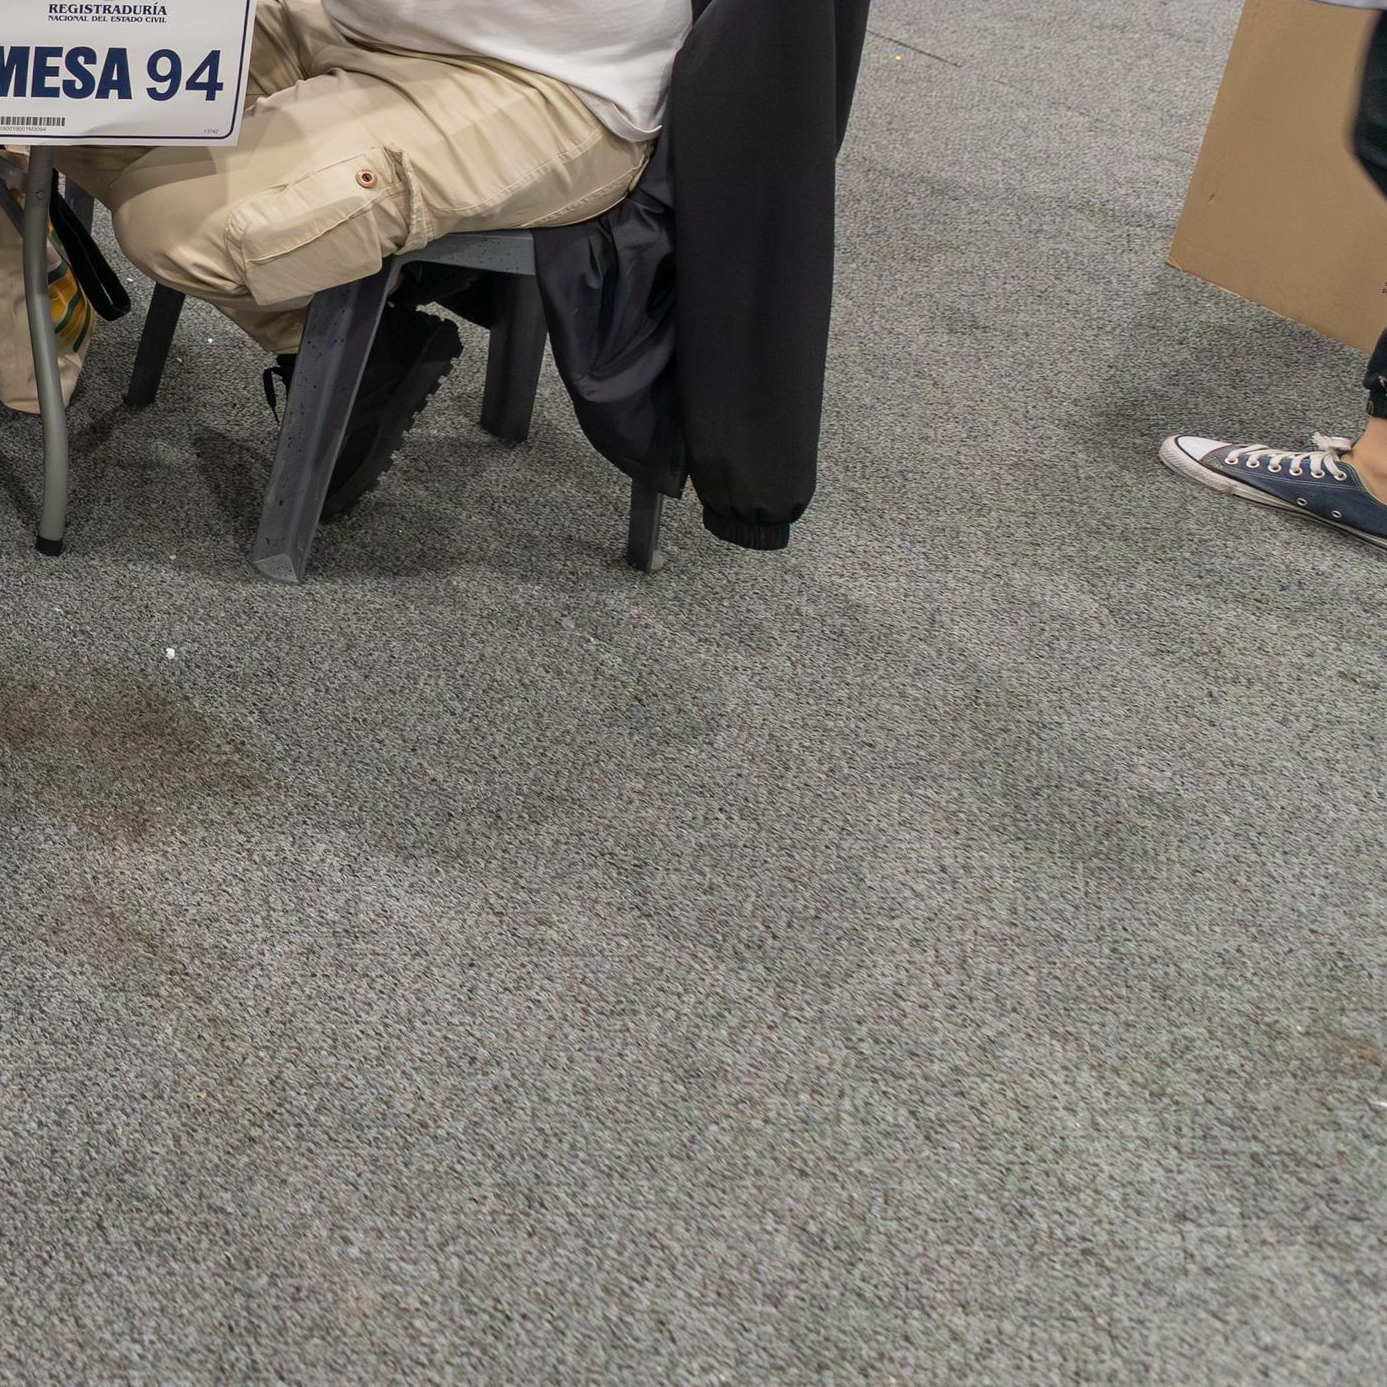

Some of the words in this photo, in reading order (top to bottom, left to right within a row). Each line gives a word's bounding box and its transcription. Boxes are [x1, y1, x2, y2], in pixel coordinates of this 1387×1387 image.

[48, 2, 167, 16] REGISTRADURÍA
[91, 15, 108, 23] DEL
[110, 15, 143, 23] ESTADO
[145, 48, 224, 102] 94
